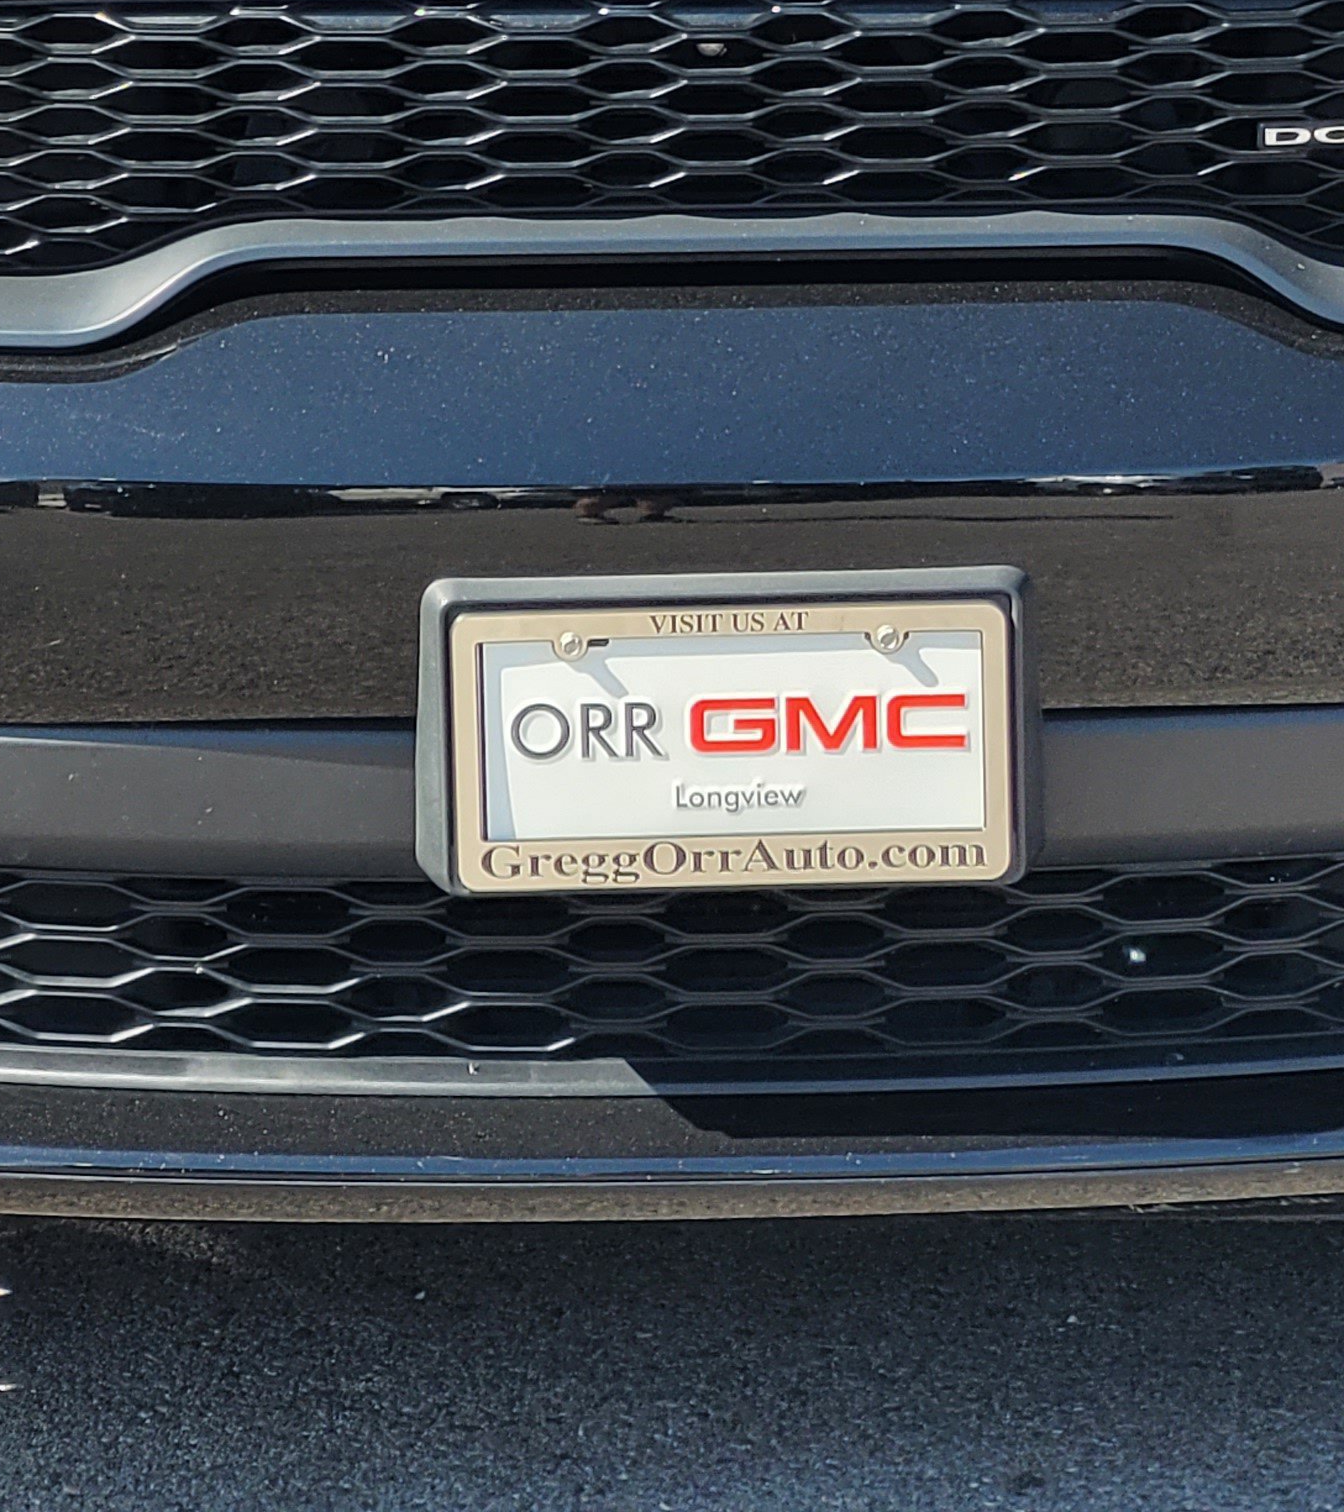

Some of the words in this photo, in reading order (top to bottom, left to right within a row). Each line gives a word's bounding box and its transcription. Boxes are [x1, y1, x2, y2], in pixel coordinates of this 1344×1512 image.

[649, 613, 723, 634] VISIT
[732, 612, 765, 632] US
[773, 611, 809, 631] AT
[510, 702, 665, 760] ORR
[689, 694, 968, 754] GMC
[674, 782, 805, 814] Longview
[481, 838, 988, 885] GreggOrrAuto.com
